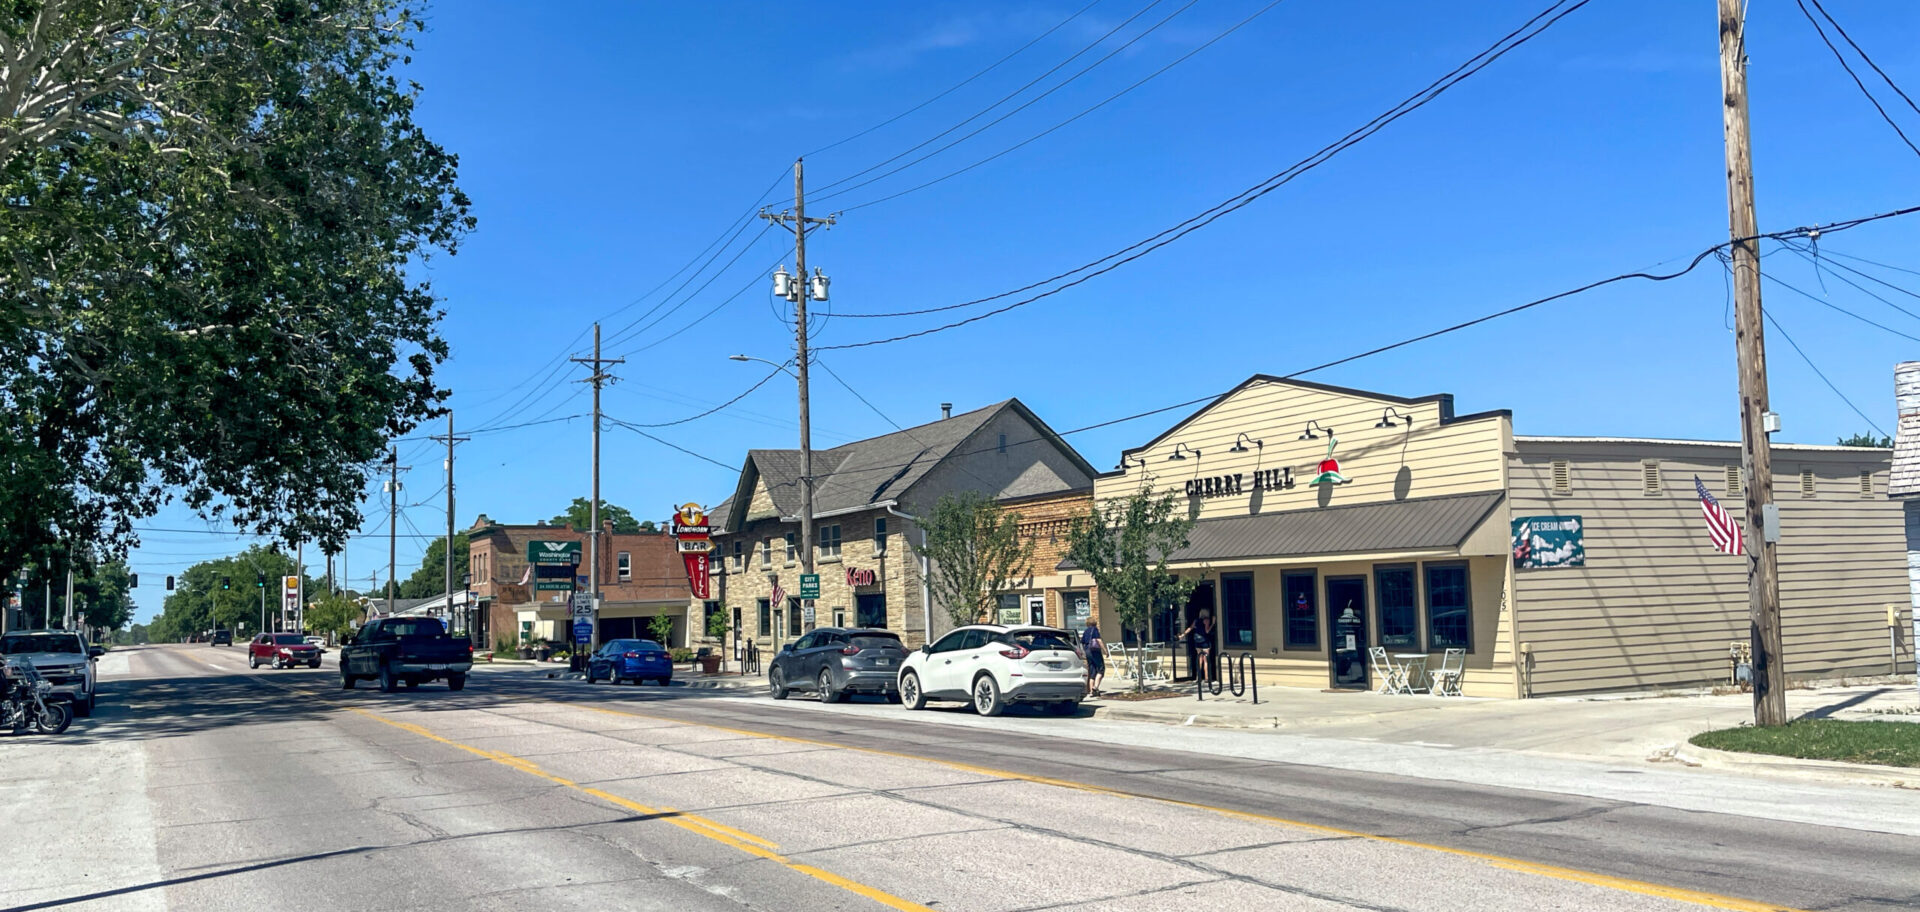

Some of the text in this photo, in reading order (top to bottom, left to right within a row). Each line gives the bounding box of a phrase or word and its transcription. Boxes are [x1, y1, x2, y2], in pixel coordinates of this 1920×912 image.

[1185, 467, 1294, 496] CHERRY HILL
[676, 523, 709, 533] LONGHORN
[1531, 521, 1559, 531] ICE CREAM
[684, 541, 707, 550] BAR
[846, 567, 874, 586] Keno
[576, 605, 592, 614] 25
